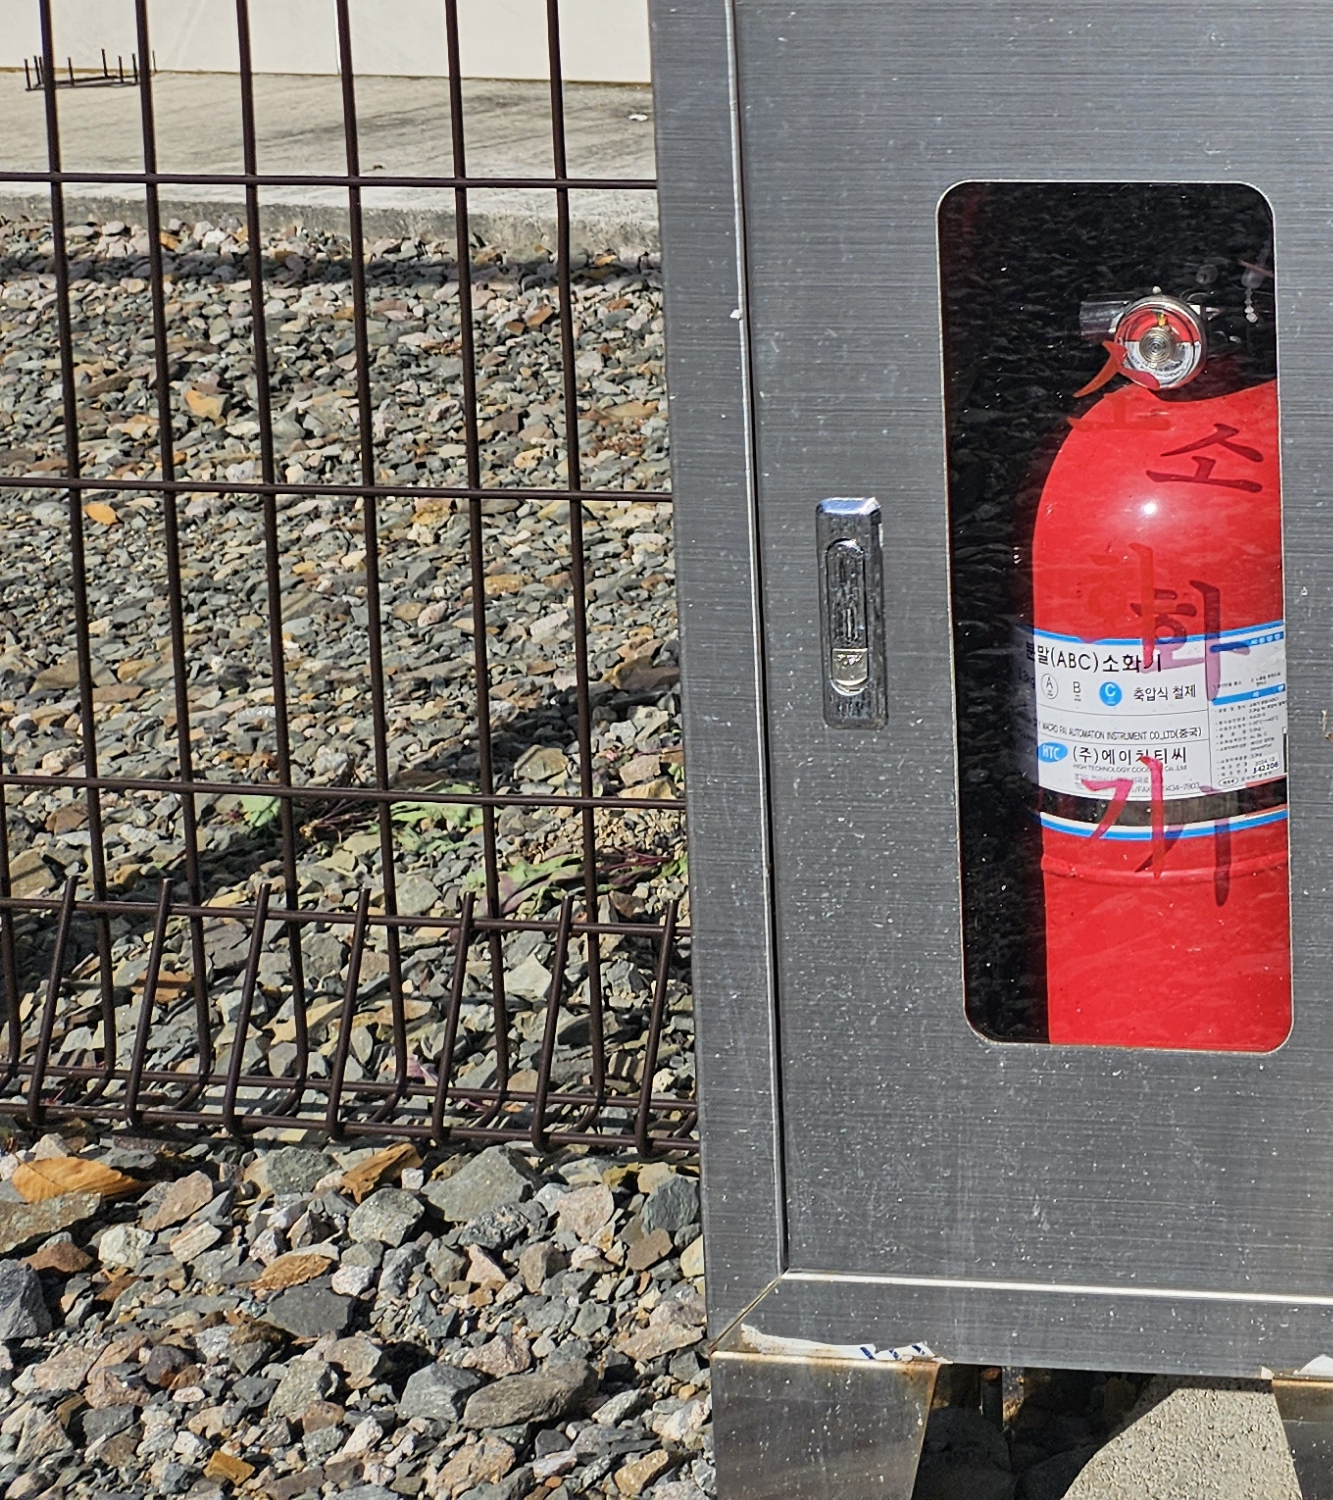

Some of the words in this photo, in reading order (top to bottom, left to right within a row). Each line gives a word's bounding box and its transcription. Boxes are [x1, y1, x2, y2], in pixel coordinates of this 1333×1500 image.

[1103, 654, 1161, 673] 소화기
[1073, 681, 1081, 693] B
[1105, 684, 1117, 697] C
[1134, 687, 1168, 701] 축압식
[1173, 684, 1196, 699] 철제
[1107, 731, 1147, 740] INSTRUMENT
[1042, 744, 1060, 760] HTC
